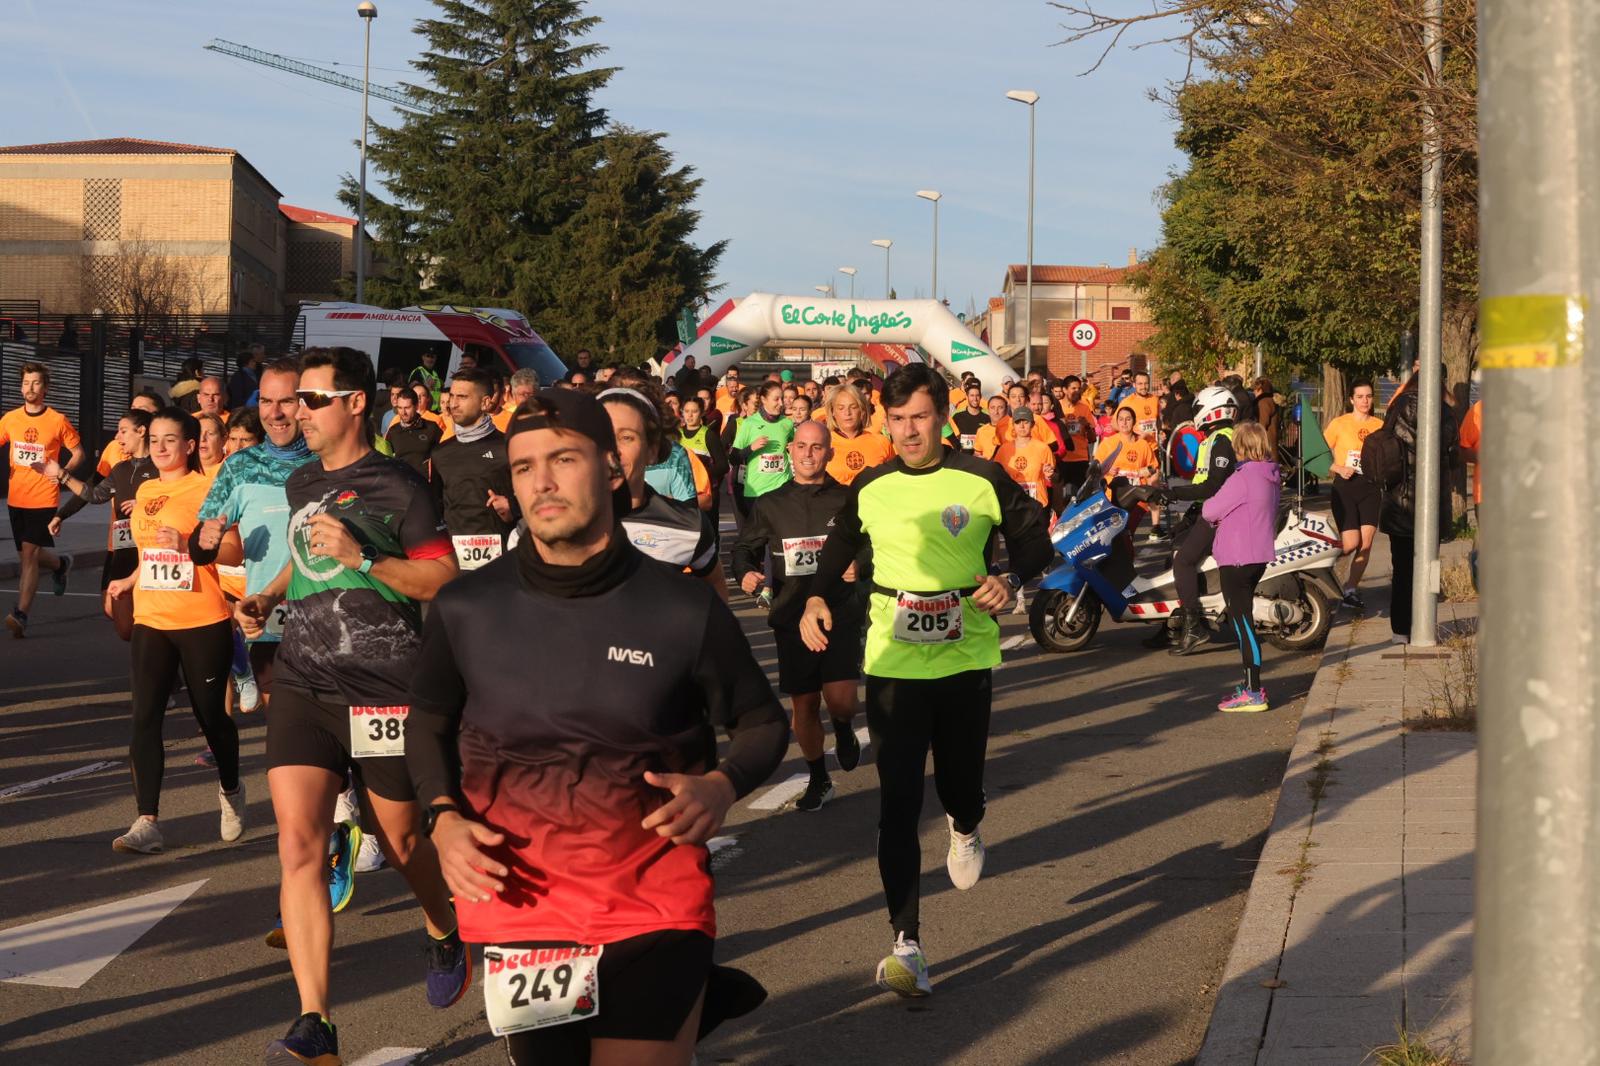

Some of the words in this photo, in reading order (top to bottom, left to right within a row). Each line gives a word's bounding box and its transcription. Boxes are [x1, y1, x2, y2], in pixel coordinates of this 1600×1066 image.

[364, 313, 421, 322] AMBULANCIA
[781, 304, 800, 325] El
[801, 306, 846, 328] Corte
[847, 304, 912, 335] Inglés
[1076, 329, 1093, 340] 30
[18, 450, 37, 461] 373
[764, 460, 779, 469] 303
[1084, 521, 1105, 538] 112
[1303, 517, 1325, 534] 112
[463, 547, 491, 561] 304
[150, 564, 181, 581] 116
[907, 612, 949, 632] 205
[607, 646, 654, 667] NASA
[508, 963, 573, 1008] 249
